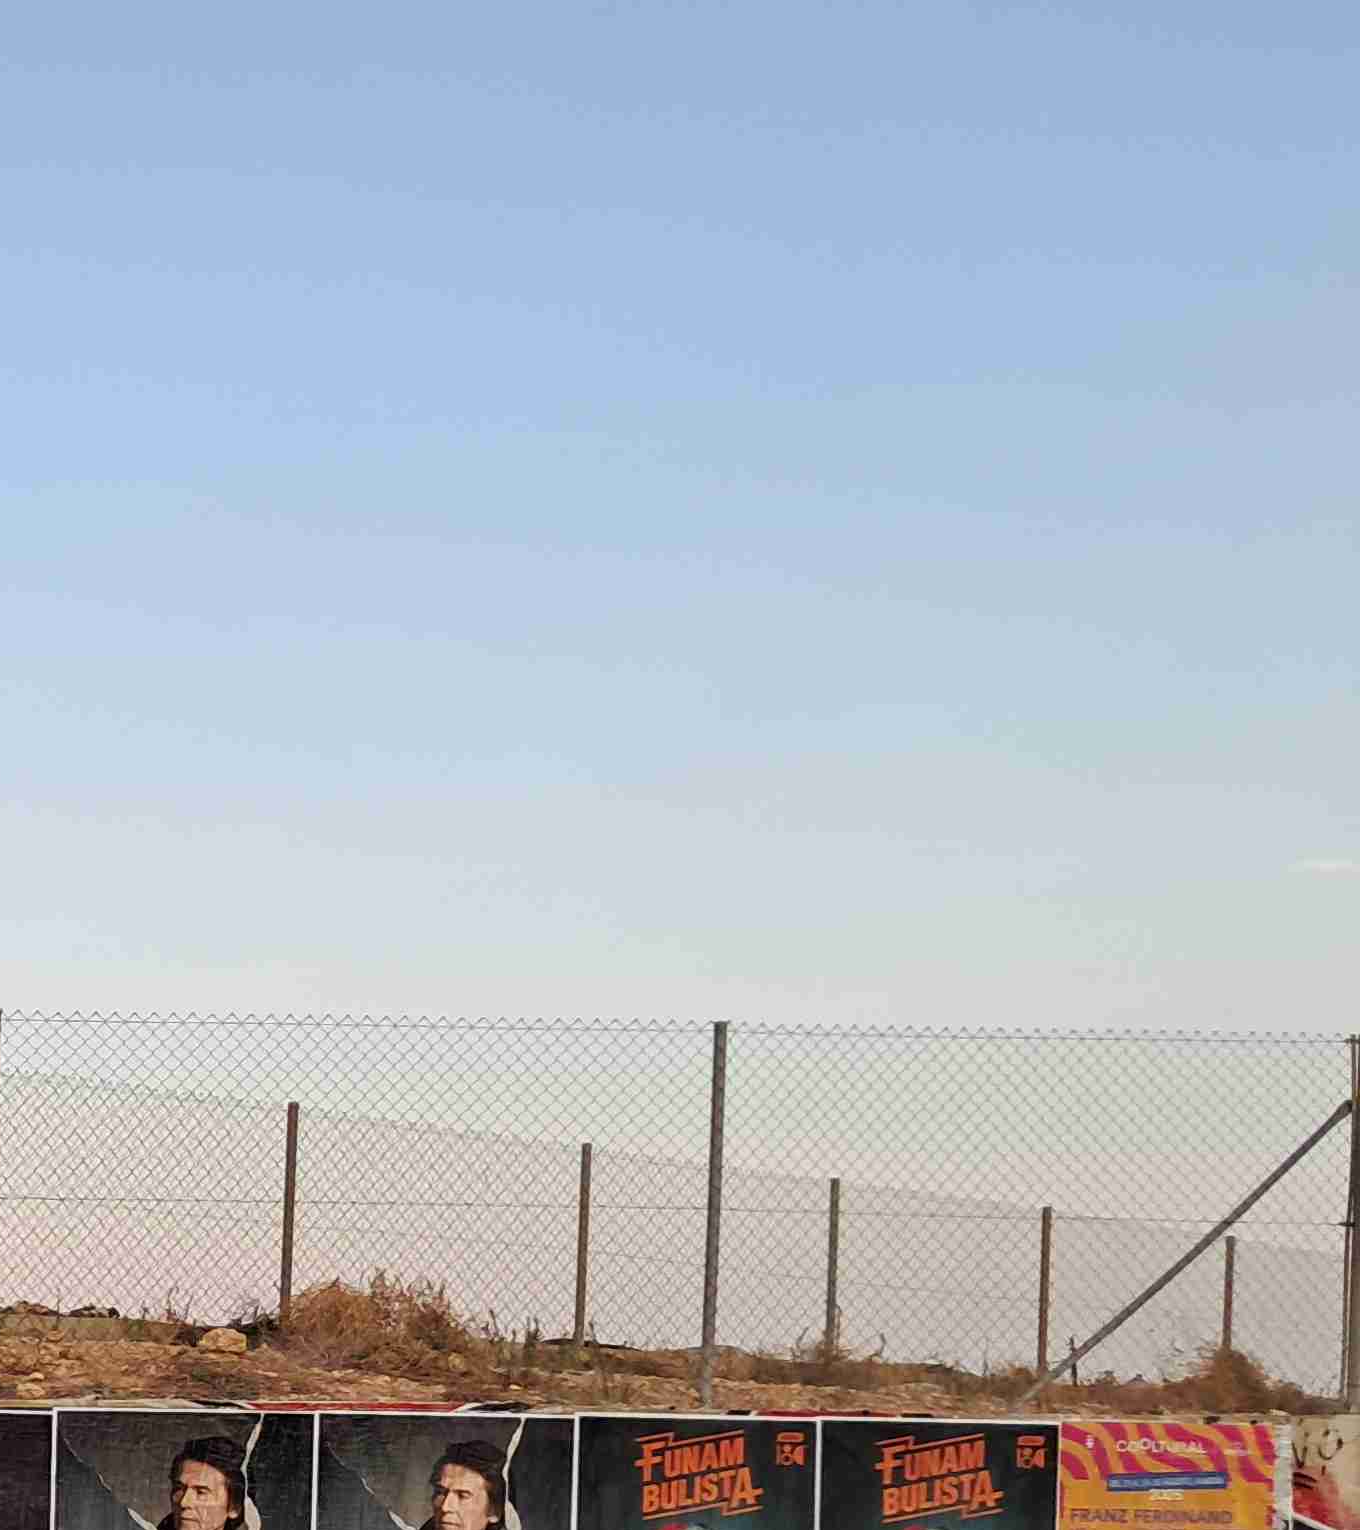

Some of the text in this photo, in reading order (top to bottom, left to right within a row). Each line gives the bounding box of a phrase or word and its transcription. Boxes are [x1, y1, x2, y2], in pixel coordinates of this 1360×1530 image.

[634, 1437, 745, 1482] FUNAM
[873, 1439, 986, 1485] FUNAM
[1115, 1437, 1208, 1455] COOLTURAL
[642, 1466, 765, 1514] BULISTA
[882, 1470, 1006, 1516] BULISTA
[1069, 1508, 1233, 1526] FRANZ FERDINAND
